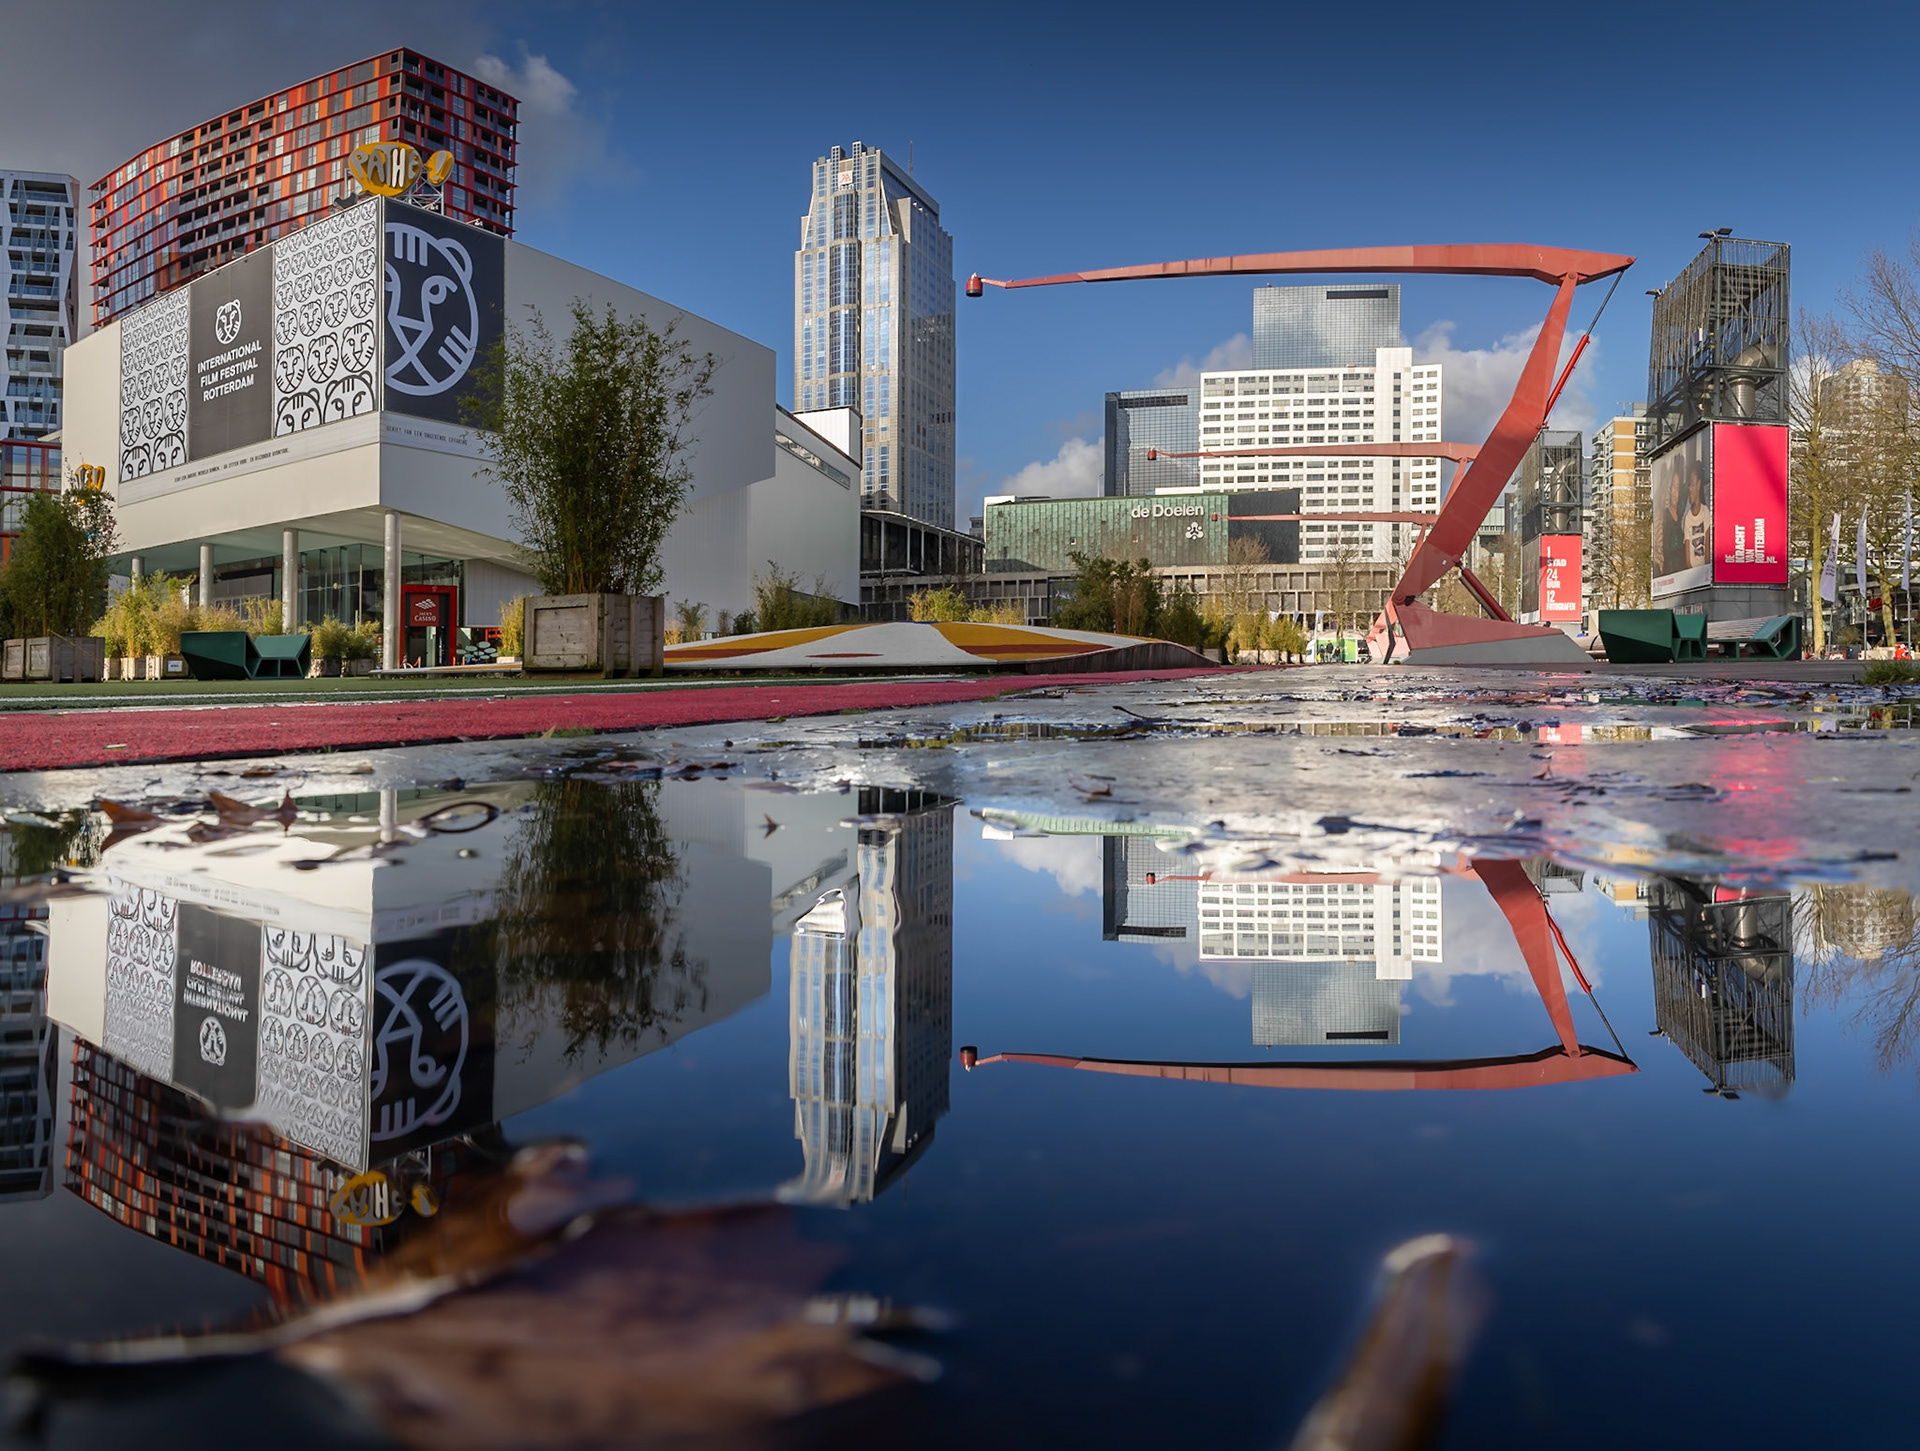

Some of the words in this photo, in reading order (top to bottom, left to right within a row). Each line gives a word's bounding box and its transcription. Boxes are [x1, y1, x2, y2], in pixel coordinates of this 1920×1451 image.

[197, 339, 262, 374] INTERNATIONAL
[200, 371, 219, 388] FILM
[220, 357, 259, 381] FESTIVAL
[203, 373, 254, 402] ROTTERDAM
[1131, 504, 1150, 519] de
[1153, 503, 1205, 518] Doelen
[1735, 524, 1745, 563] KRACHT
[1754, 518, 1765, 564] ROTTERDAM
[1546, 546, 1552, 558] 1
[1725, 554, 1735, 563] DE
[1745, 548, 1755, 563] VAN
[1546, 558, 1567, 567] STAD
[1546, 568, 1558, 581] 24
[1546, 580, 1561, 589] UUR
[1546, 590, 1556, 602] 12
